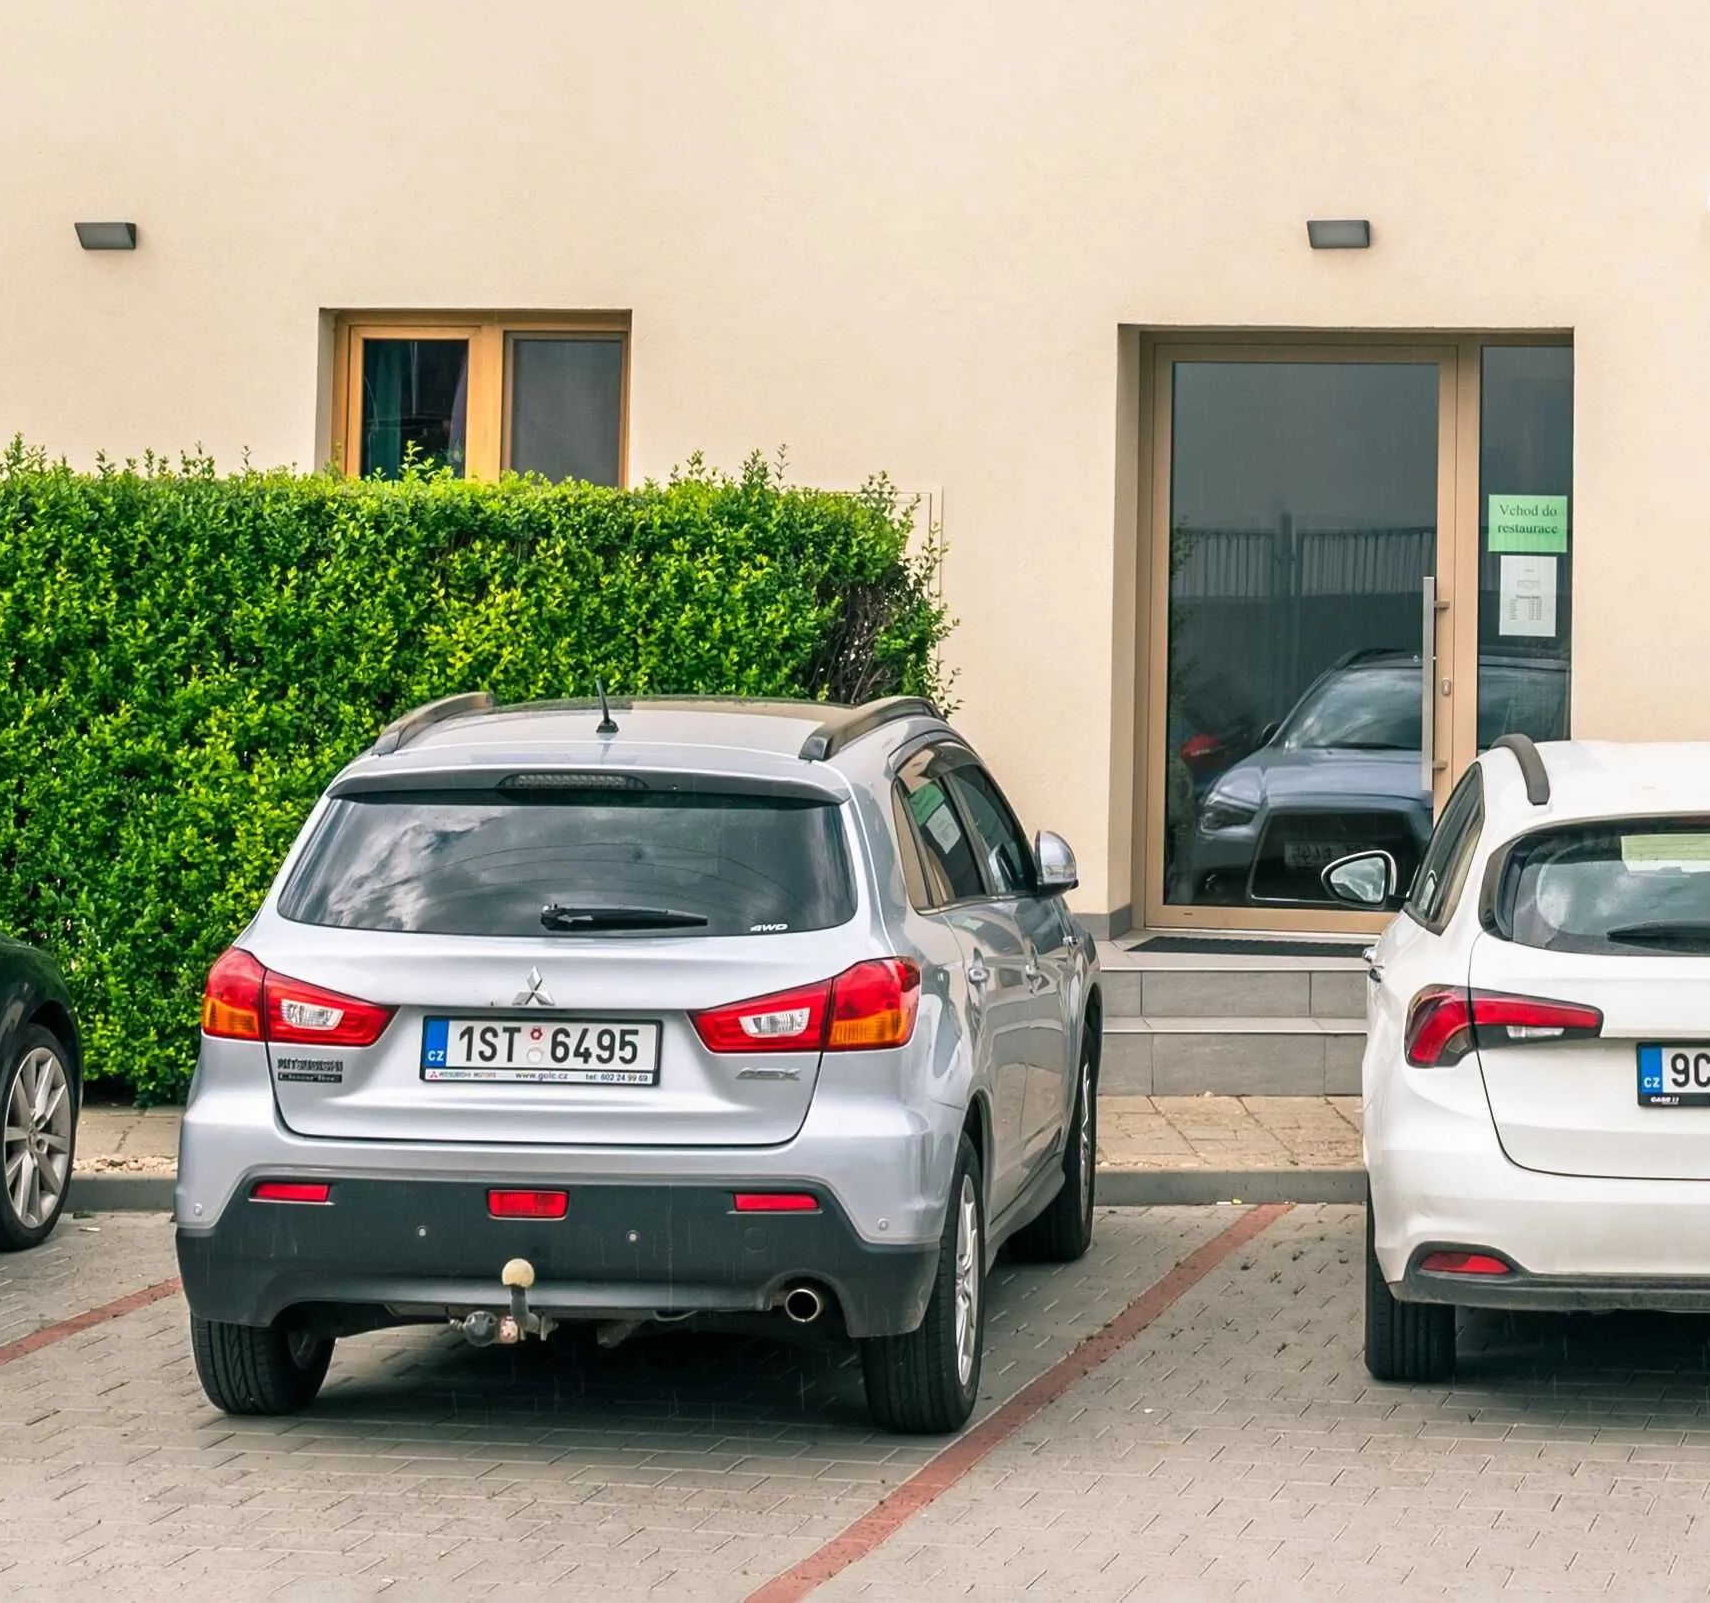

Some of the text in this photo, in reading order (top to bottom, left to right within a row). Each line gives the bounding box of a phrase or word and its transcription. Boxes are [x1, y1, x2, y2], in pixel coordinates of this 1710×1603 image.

[1499, 504, 1558, 517] Vchod do
[1497, 523, 1559, 534] restaurace
[750, 923, 789, 932] 4WD
[427, 1025, 640, 1065] CZ 1ST 6495
[1643, 1077, 1661, 1088] CZ
